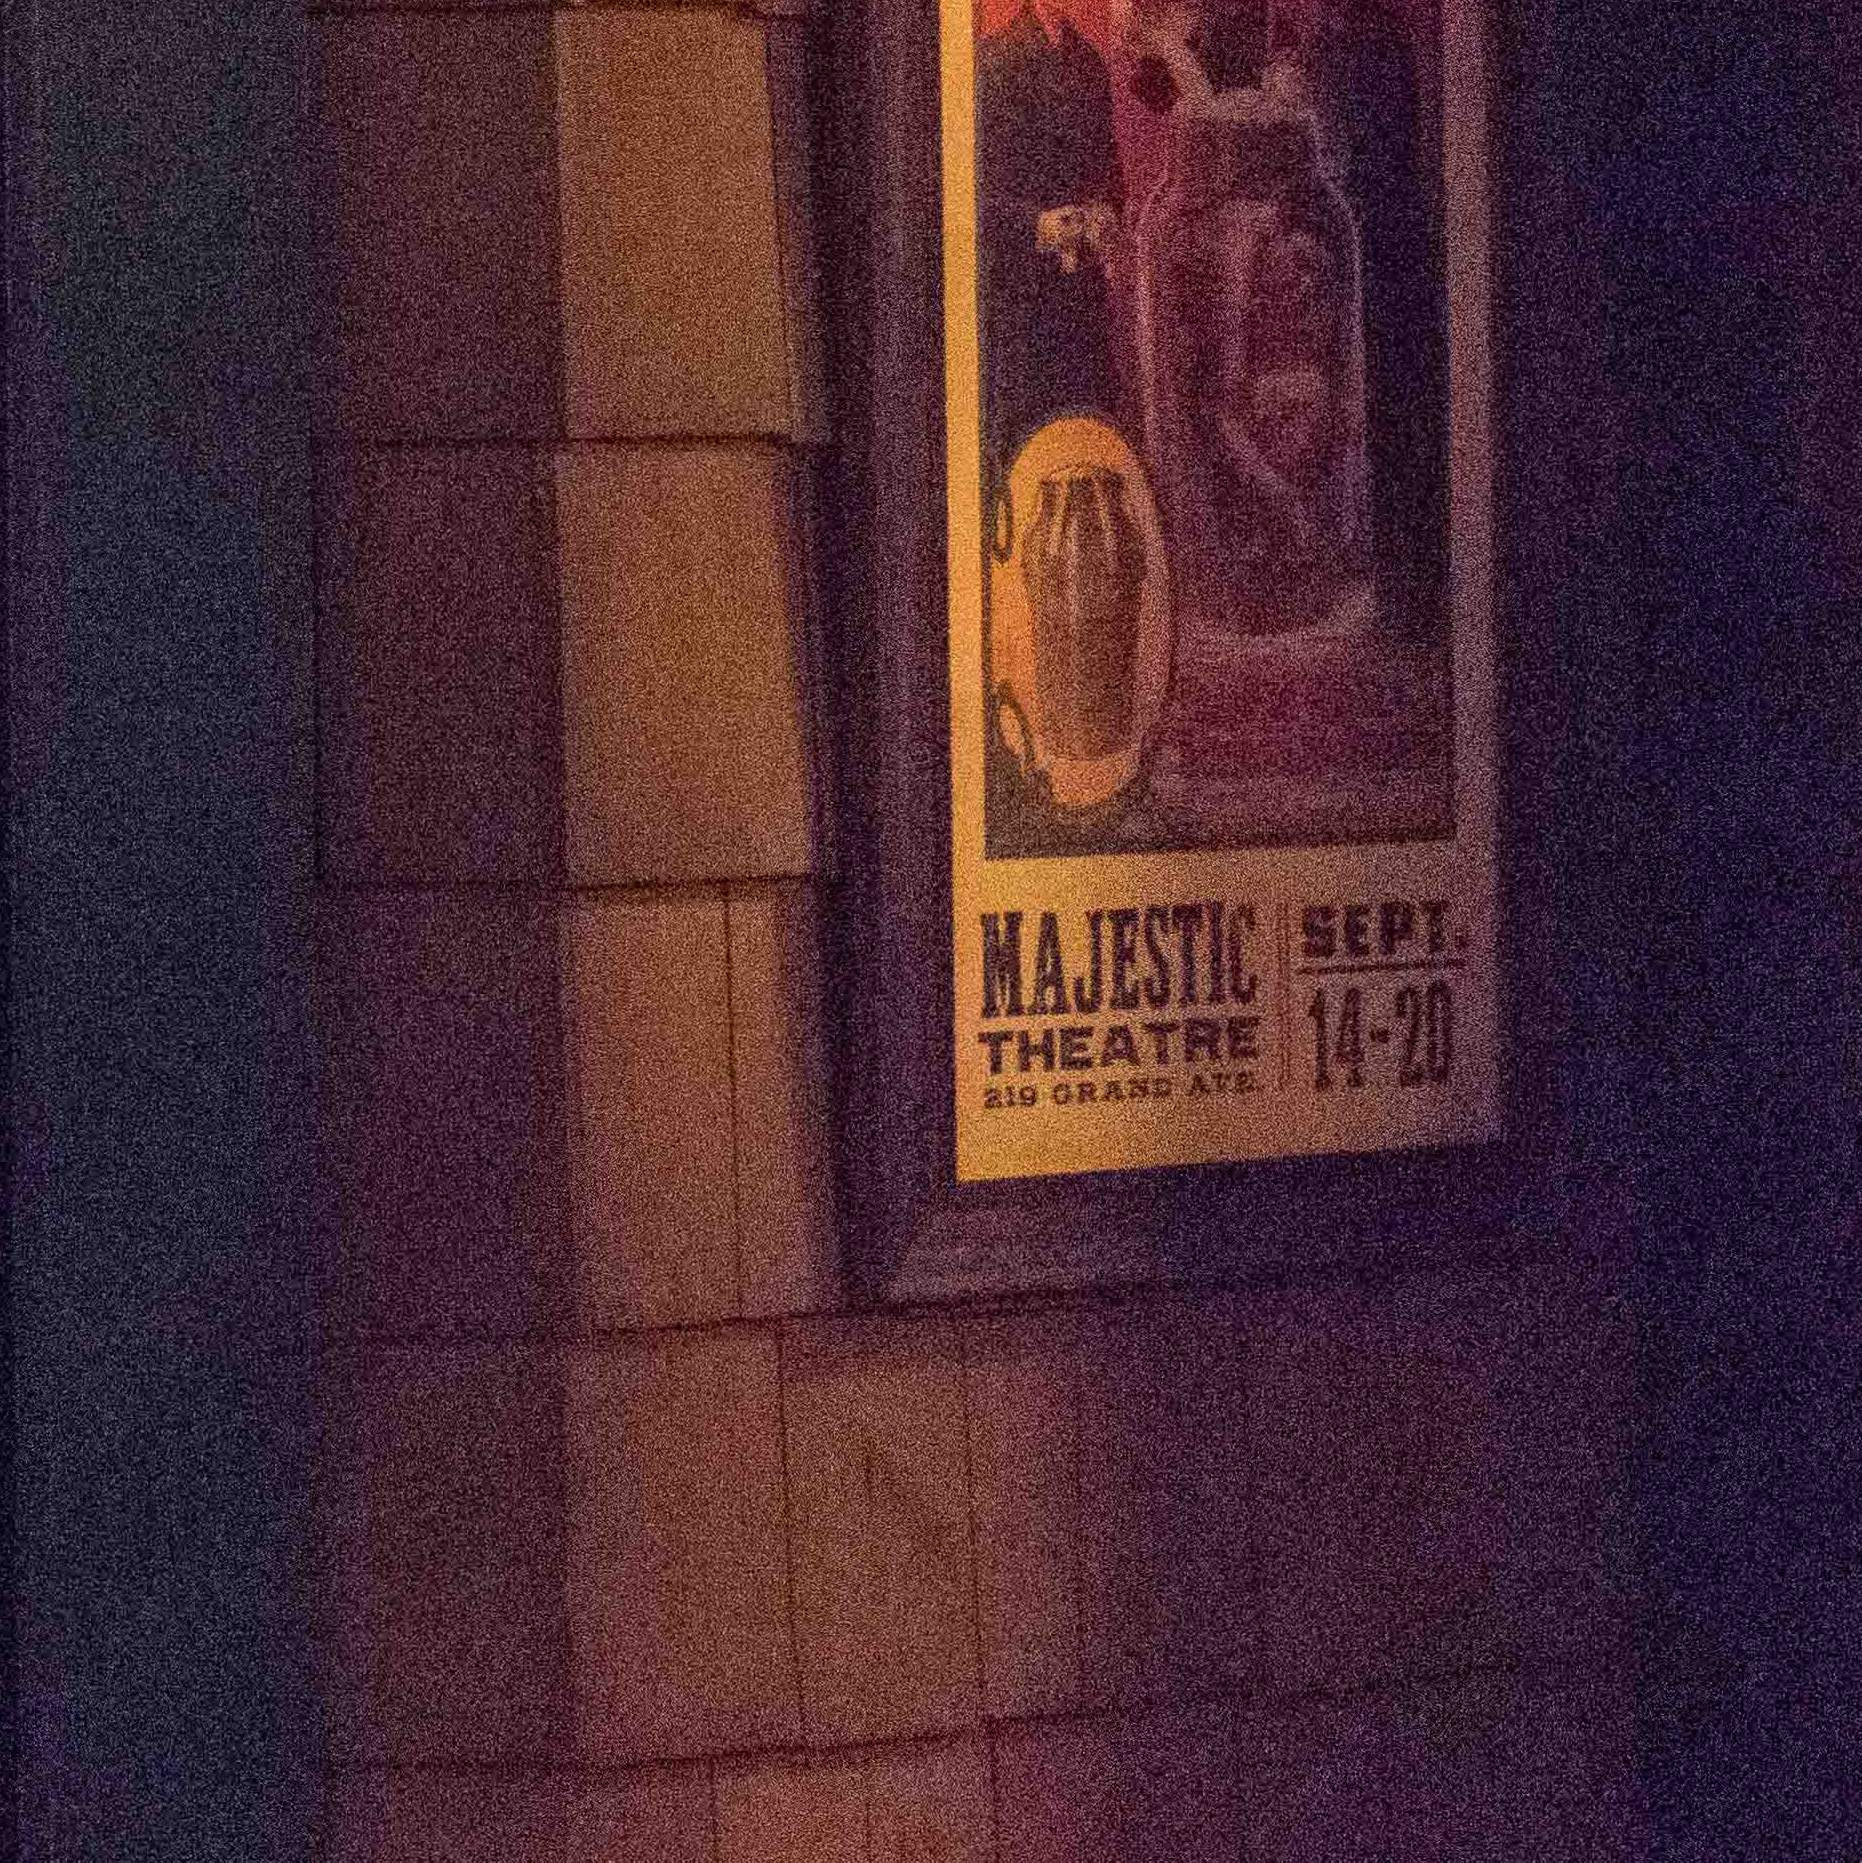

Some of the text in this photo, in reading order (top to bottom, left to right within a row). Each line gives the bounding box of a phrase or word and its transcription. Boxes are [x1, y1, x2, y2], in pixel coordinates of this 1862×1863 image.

[1304, 902, 1470, 957] SEPT.
[980, 904, 1259, 1016] MAJESTIC
[978, 1018, 1261, 1074] THEATRE
[1310, 983, 1455, 1091] 14-20
[984, 1085, 1039, 1110] 219
[1051, 1075, 1173, 1107] GRAND
